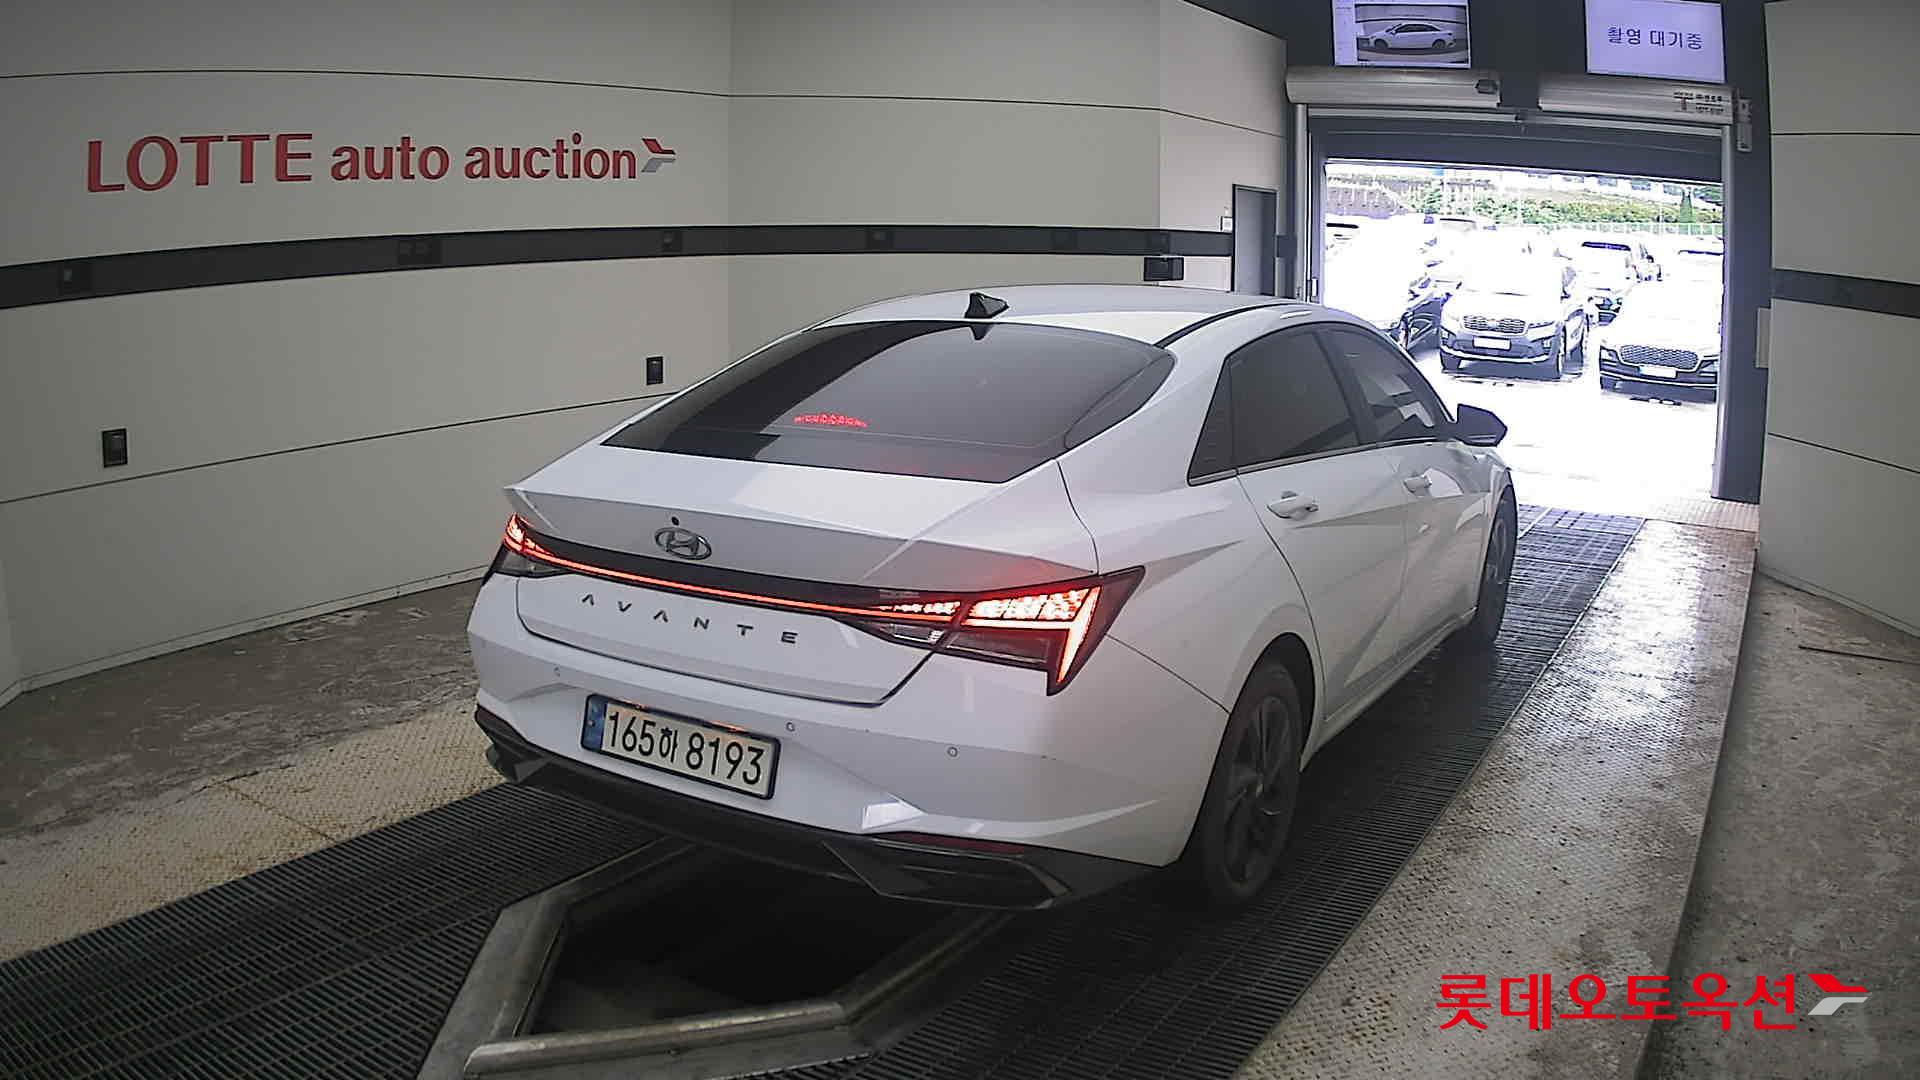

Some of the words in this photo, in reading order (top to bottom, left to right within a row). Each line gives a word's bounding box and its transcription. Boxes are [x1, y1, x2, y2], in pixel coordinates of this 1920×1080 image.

[1608, 27, 1641, 45] 촬영
[1649, 30, 1703, 49] 대기중
[87, 133, 313, 192] LOTTE
[330, 137, 450, 181] auto
[463, 132, 637, 180] auction
[581, 594, 798, 644] AVANTE
